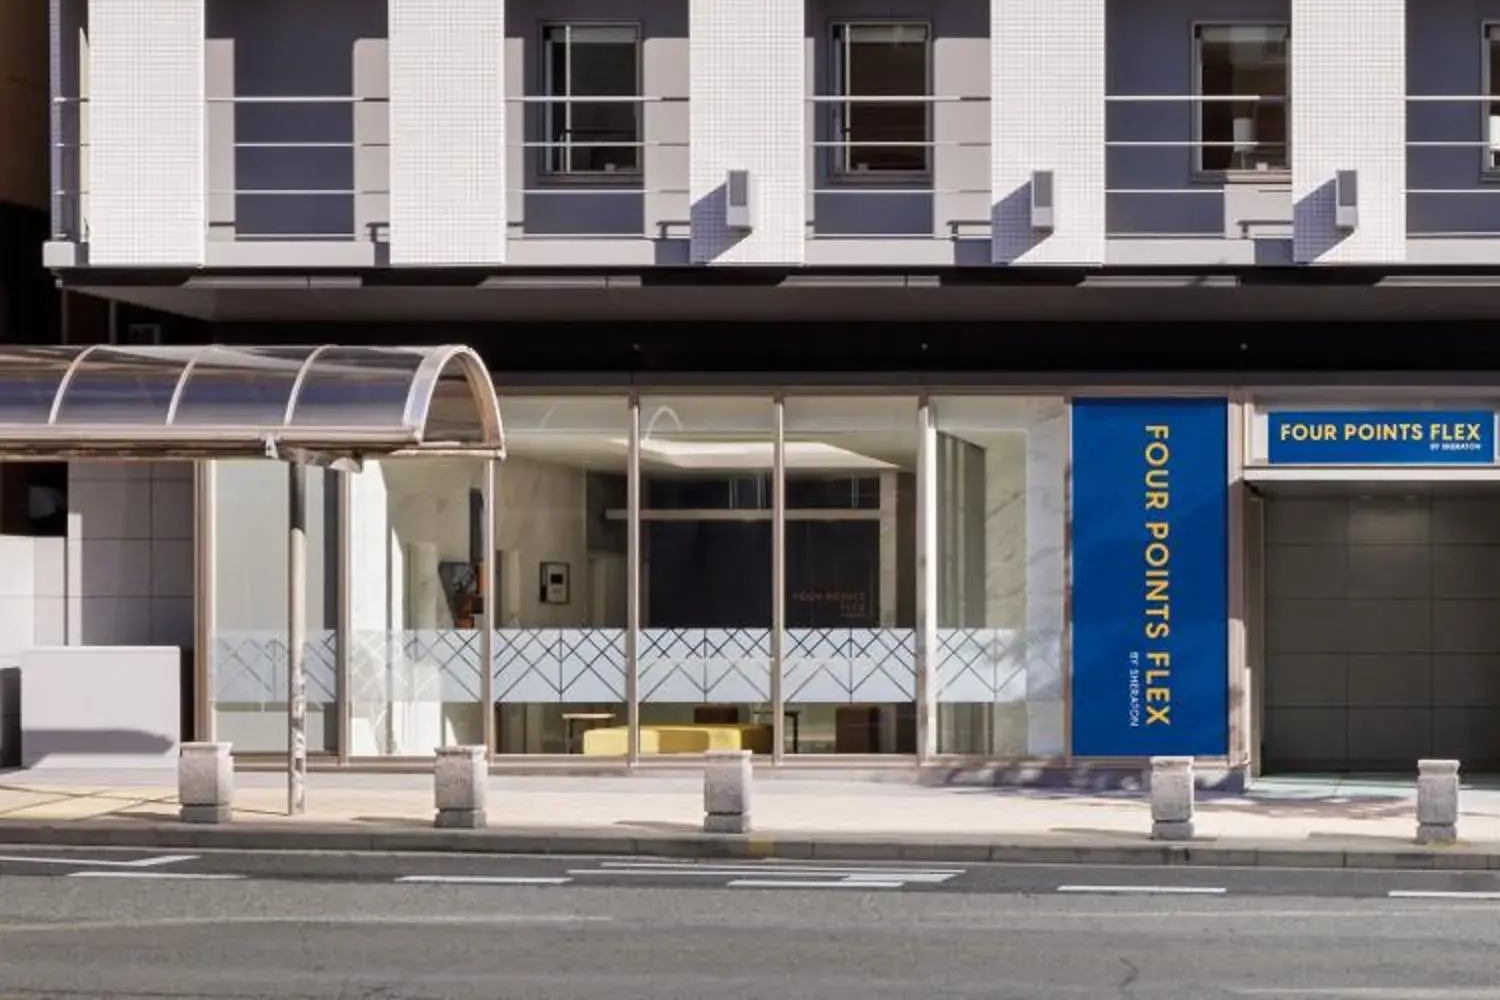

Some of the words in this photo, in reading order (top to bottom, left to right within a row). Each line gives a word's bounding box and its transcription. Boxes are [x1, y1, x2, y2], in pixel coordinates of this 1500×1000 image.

[1280, 423, 1337, 441] FOUR
[1344, 423, 1423, 441] POINTS
[1430, 423, 1481, 441] FLEX
[1145, 425, 1169, 509] FOUR
[1145, 522, 1169, 639] POINTS
[1129, 651, 1139, 666] BY
[1145, 651, 1170, 724] FLEX
[1129, 669, 1139, 727] SHERATON
